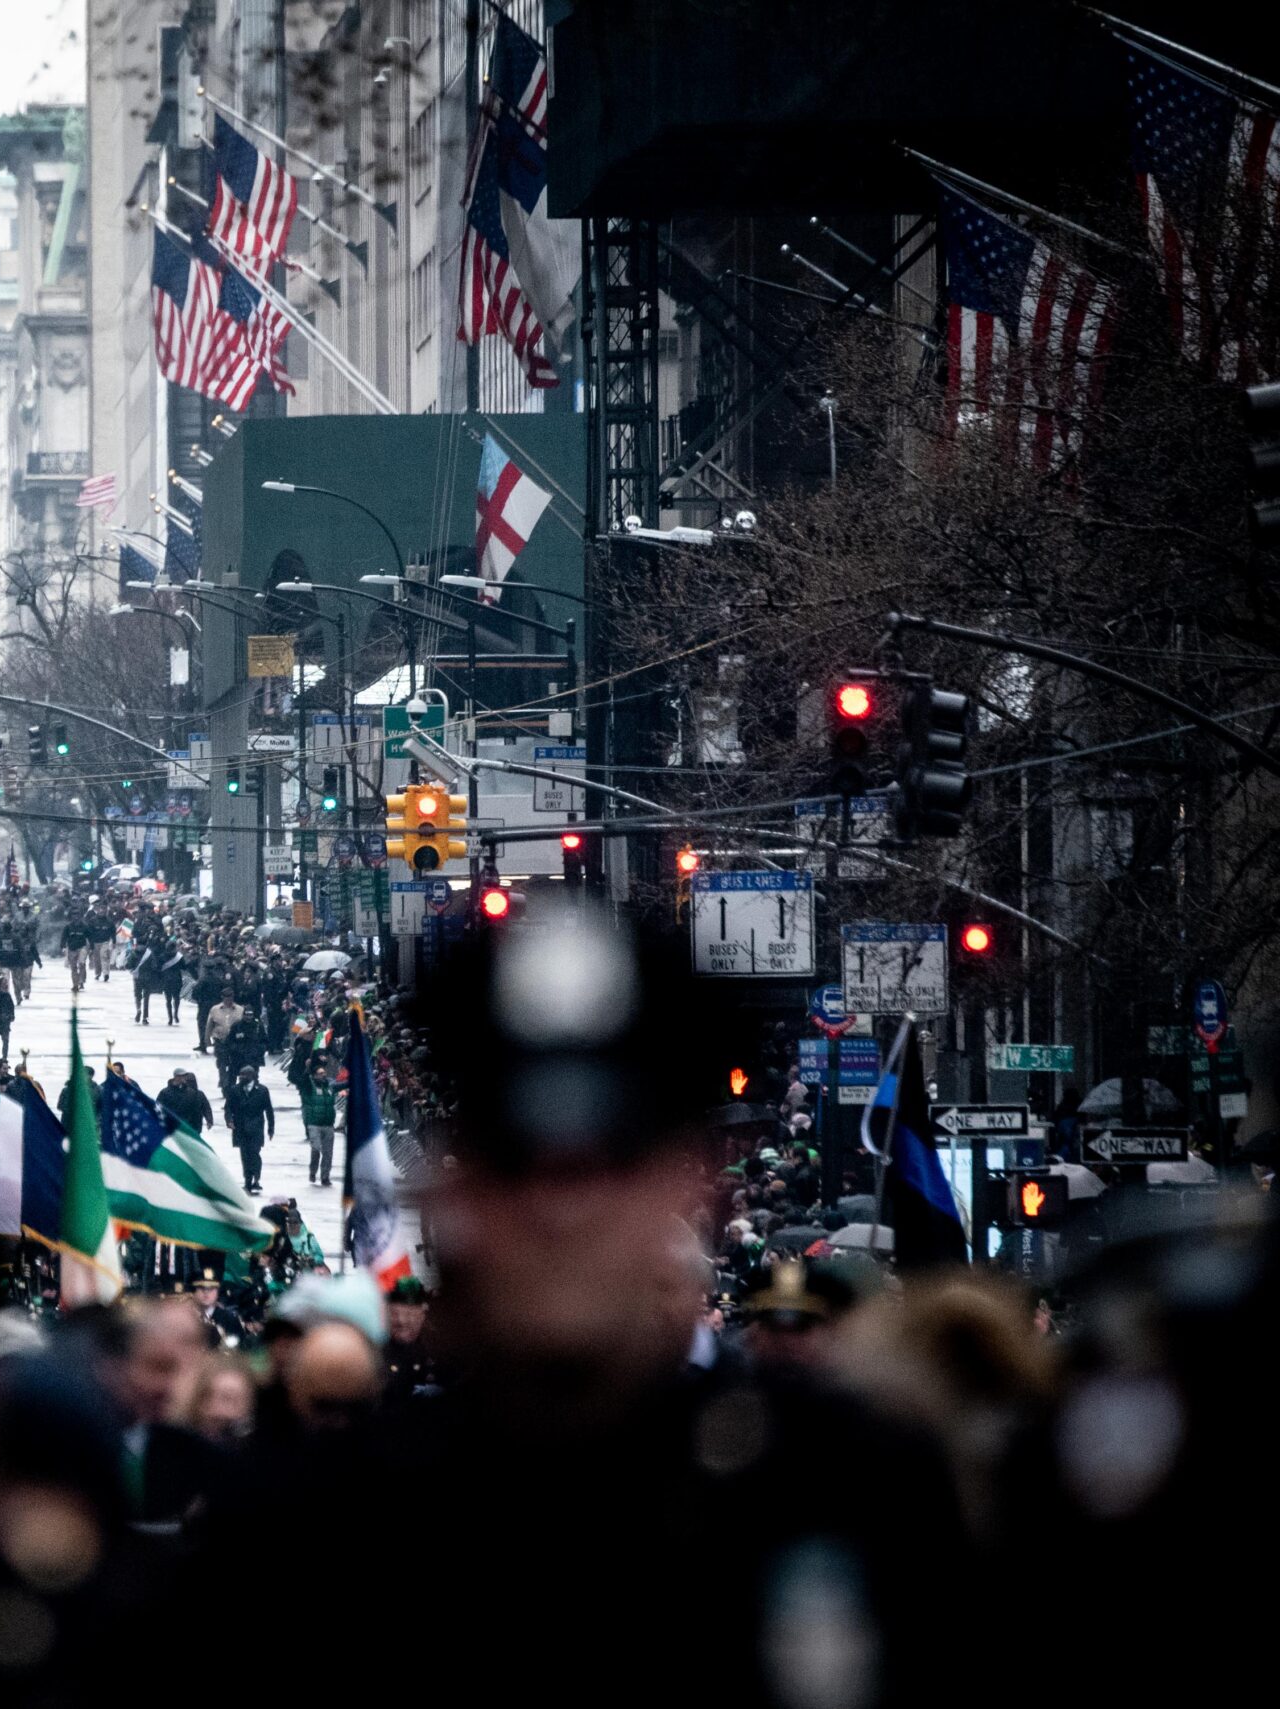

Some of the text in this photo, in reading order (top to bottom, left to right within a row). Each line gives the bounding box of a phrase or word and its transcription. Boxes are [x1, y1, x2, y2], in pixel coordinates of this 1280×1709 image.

[945, 1115, 1016, 1129] ONE WAY
[1099, 1139, 1172, 1154] ONE WAY
